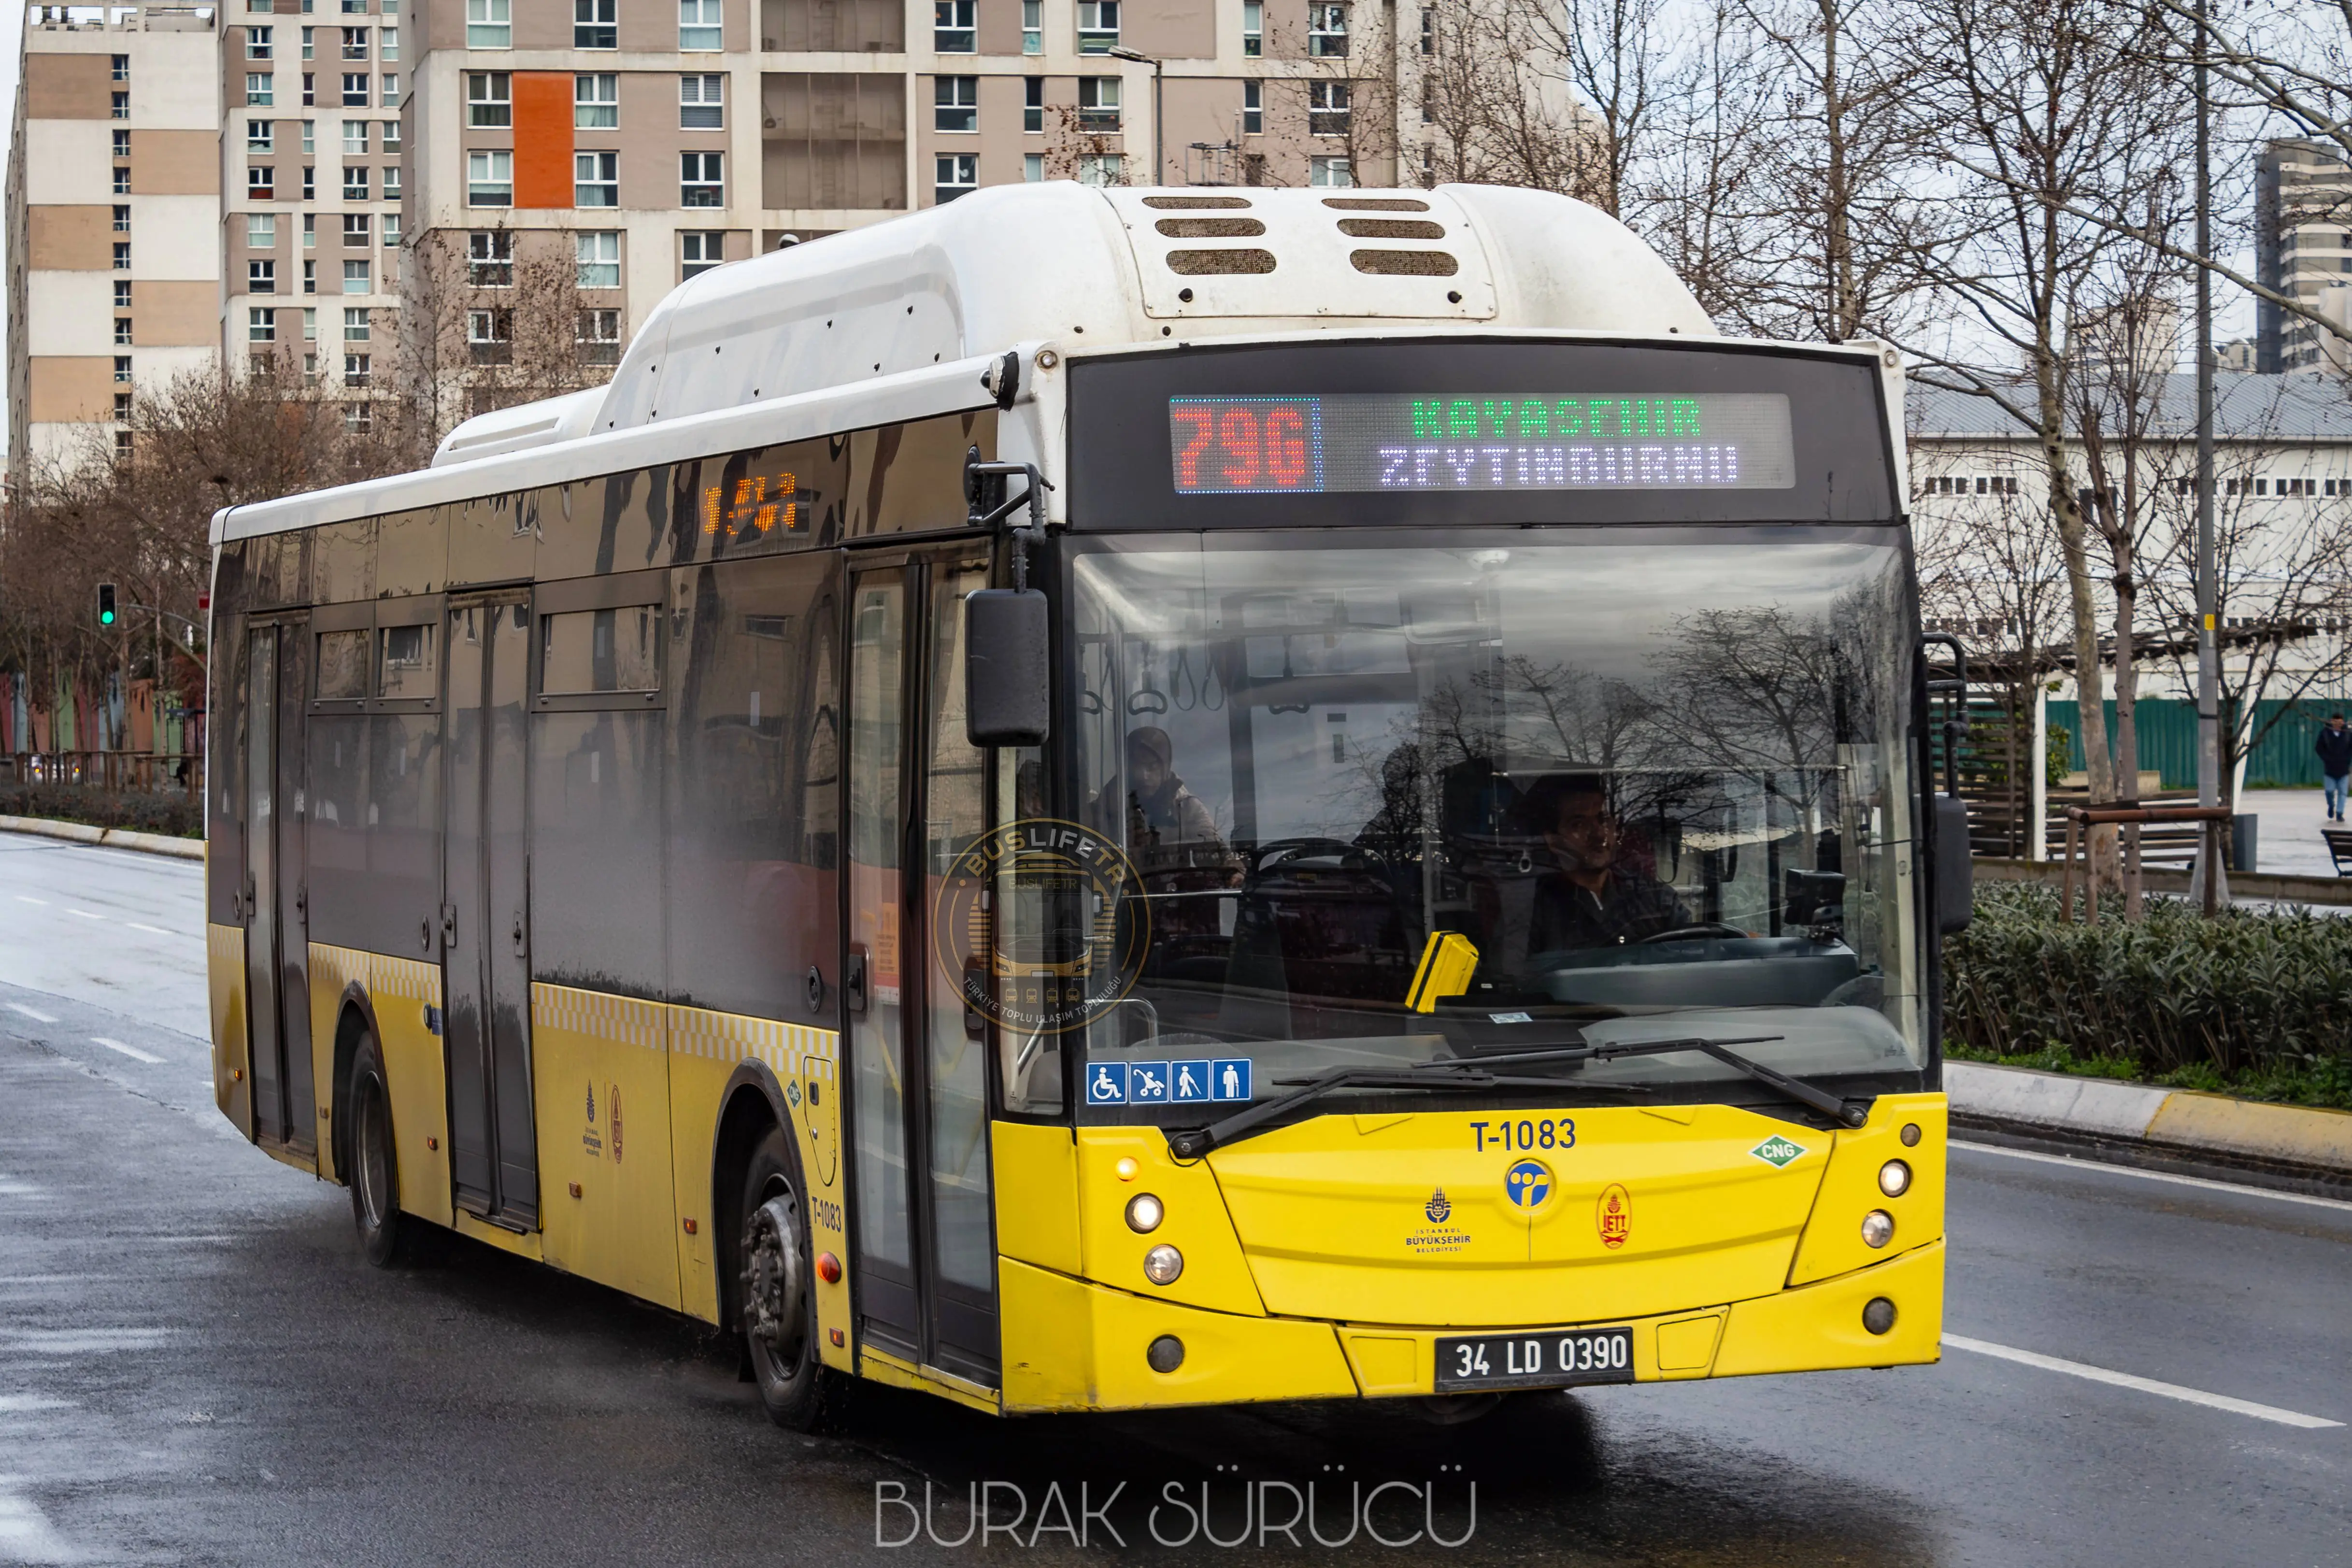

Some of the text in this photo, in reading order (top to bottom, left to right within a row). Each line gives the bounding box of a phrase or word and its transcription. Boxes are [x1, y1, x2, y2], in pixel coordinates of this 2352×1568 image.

[1470, 1118, 1576, 1152] T-1083
[1761, 1143, 1795, 1158] CNG
[812, 1196, 841, 1233] T-1083
[1406, 1234, 1471, 1245] BÜYÜKŞEHİR
[1456, 1335, 1627, 1377] 34 LD 0390
